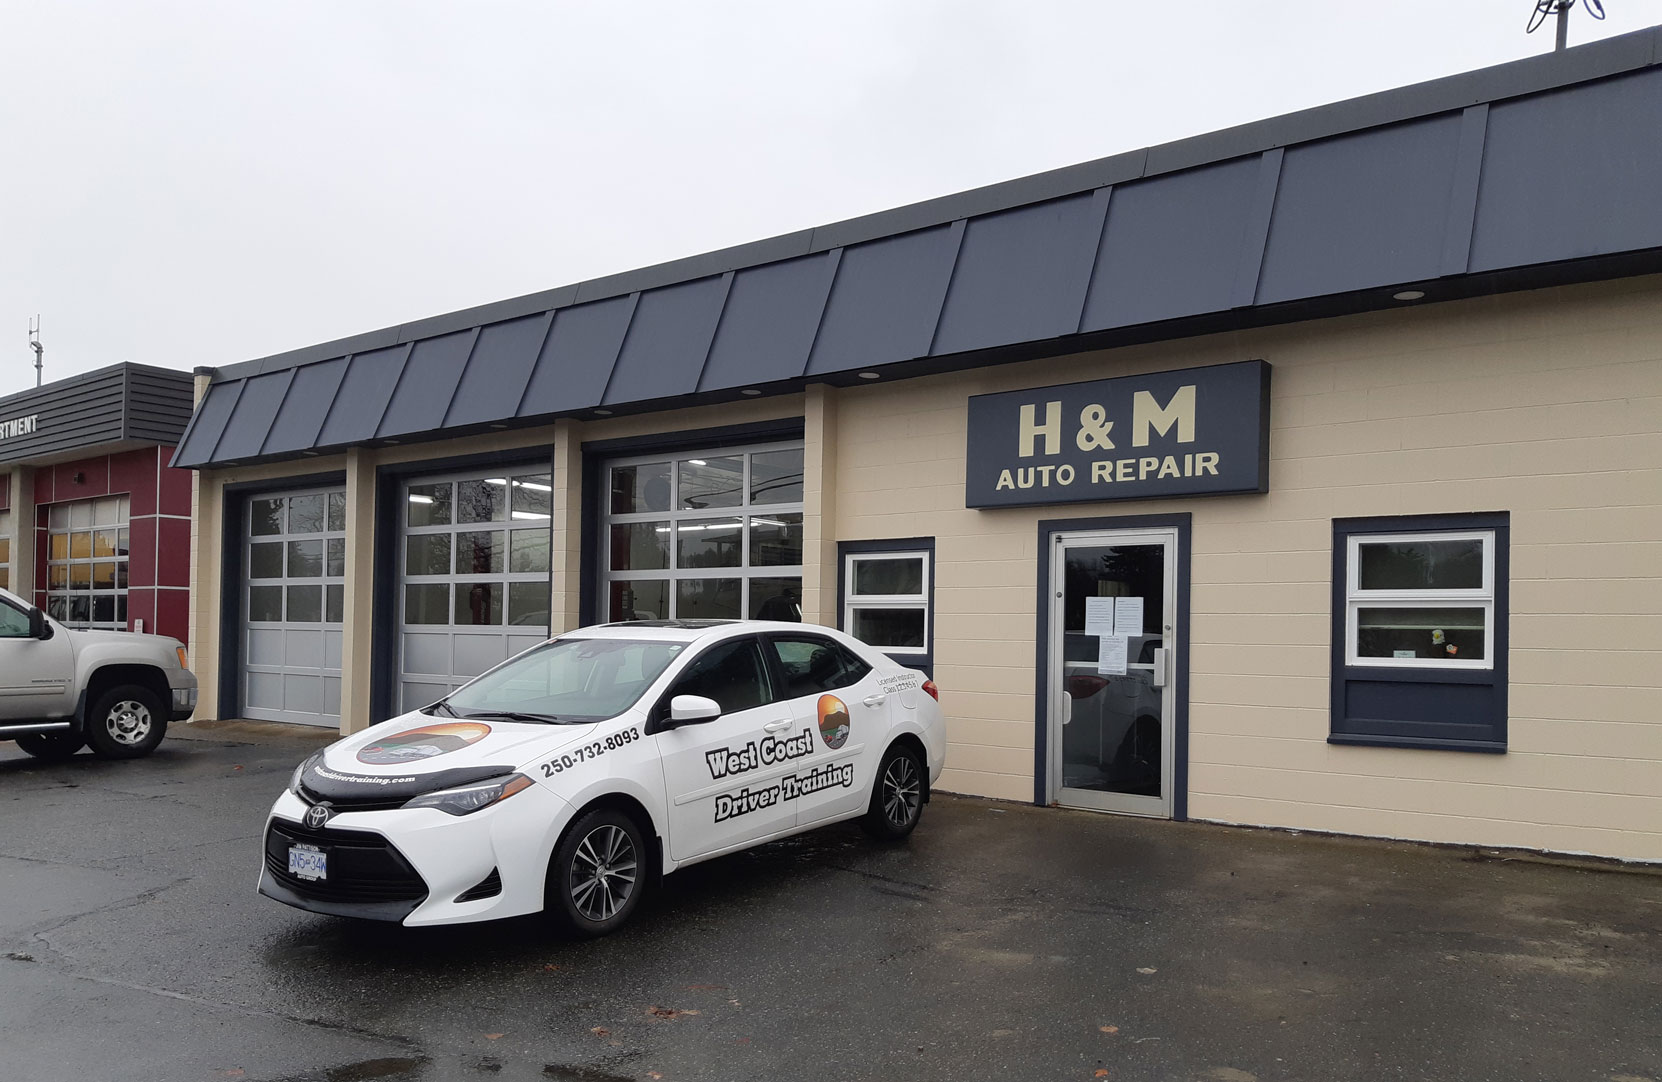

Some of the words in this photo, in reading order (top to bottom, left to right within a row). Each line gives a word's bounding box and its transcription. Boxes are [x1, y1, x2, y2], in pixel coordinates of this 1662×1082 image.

[1018, 401, 1062, 458] H
[1076, 403, 1115, 452] &
[1131, 384, 1197, 448] M
[995, 464, 1075, 491] AUTO
[1091, 452, 1220, 484] REPAIR
[883, 685, 897, 695] Class
[540, 727, 640, 778] 250-732-8093
[705, 741, 758, 780] West
[760, 728, 813, 766] Coast
[714, 785, 780, 823] Driver
[781, 763, 853, 801] Training
